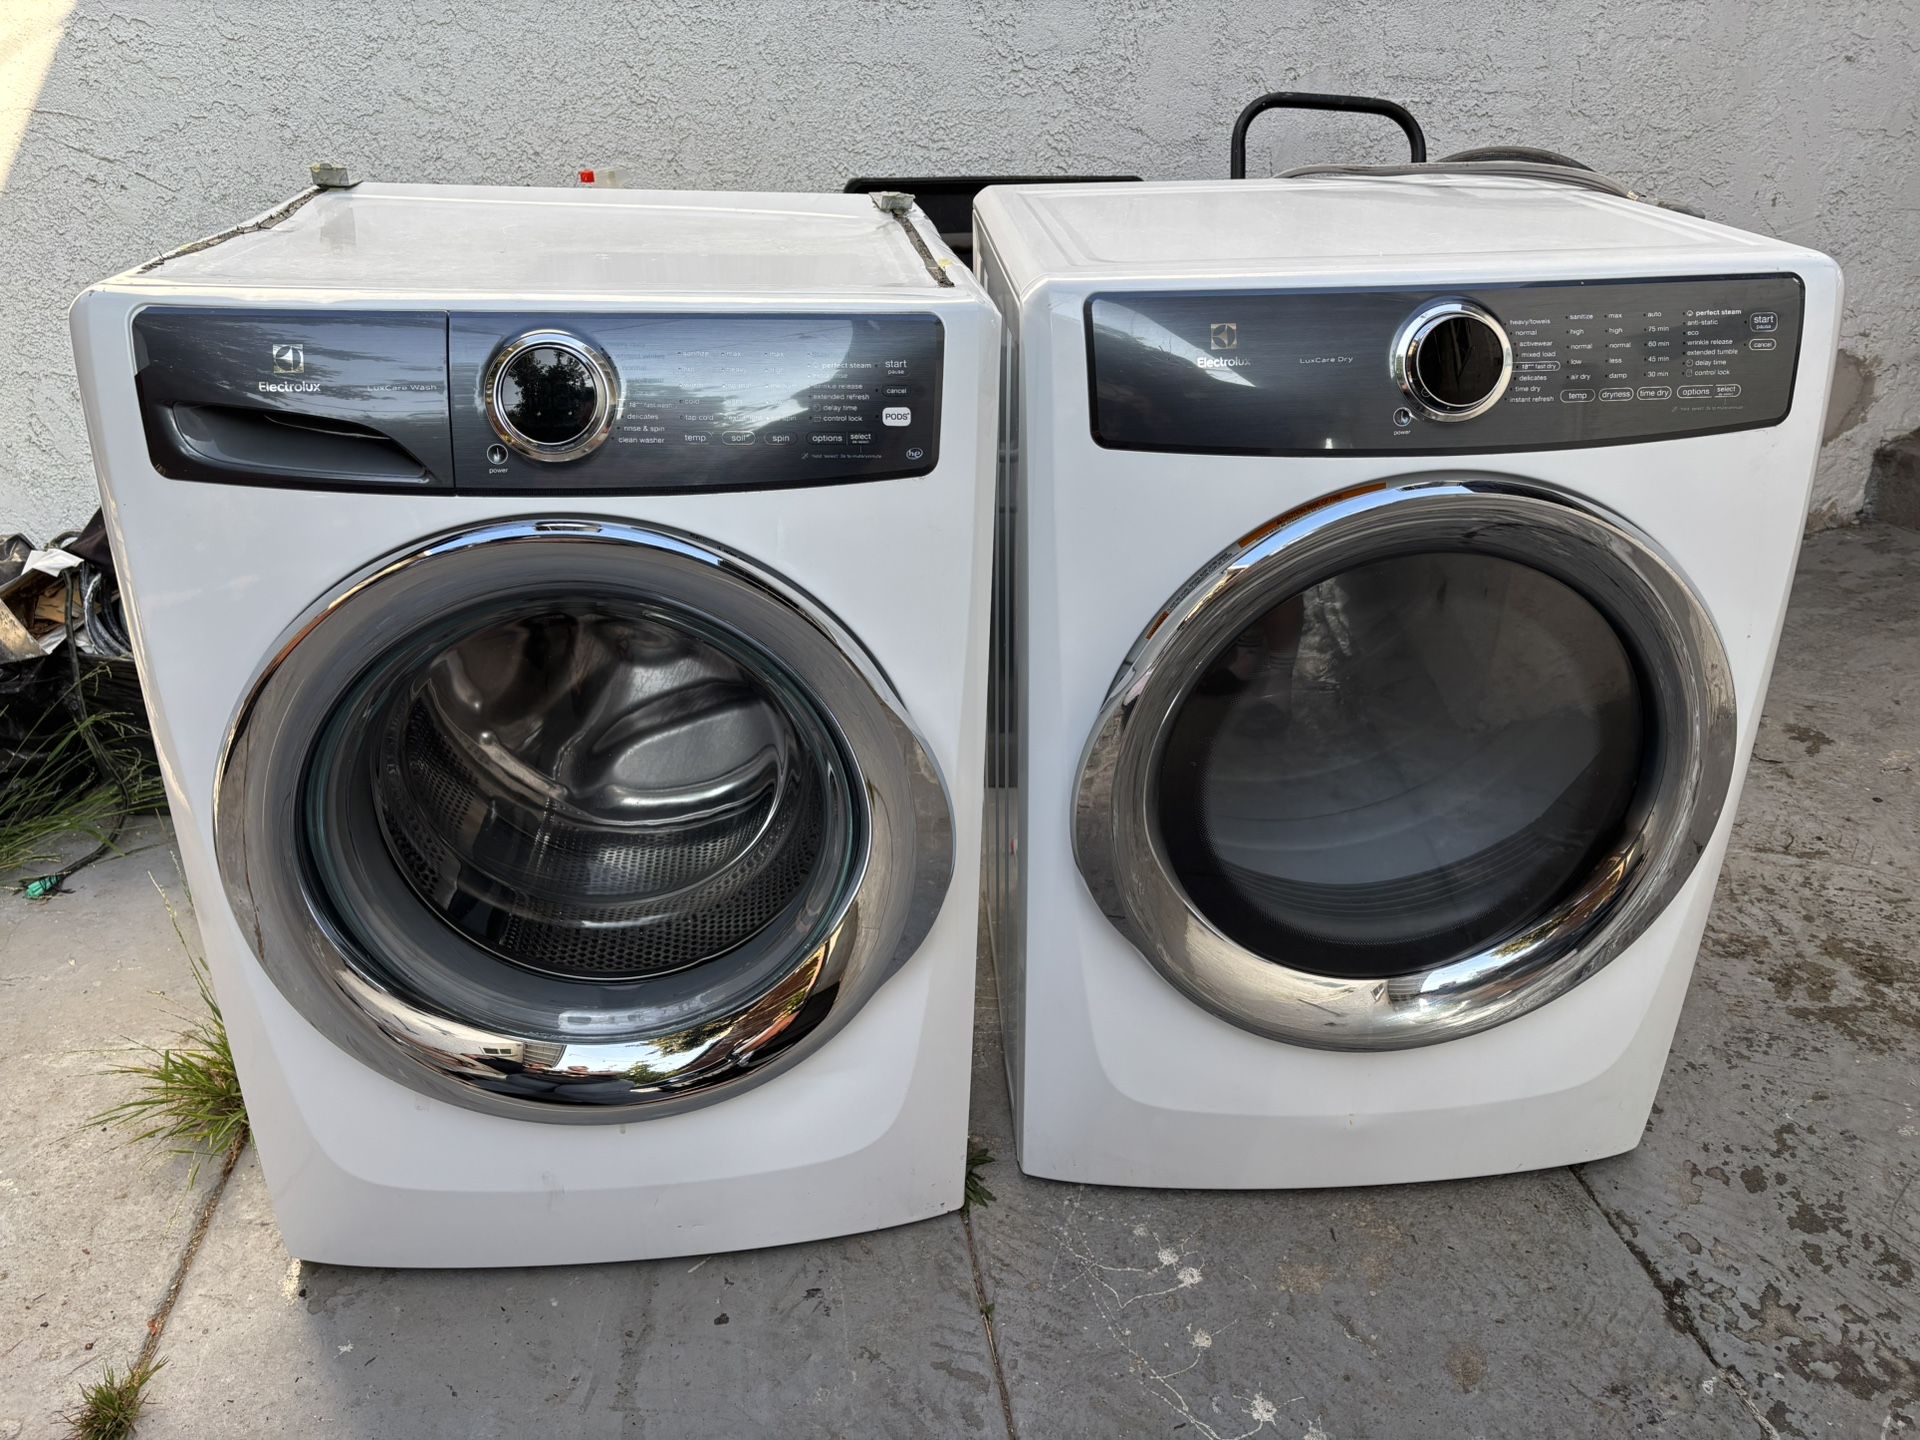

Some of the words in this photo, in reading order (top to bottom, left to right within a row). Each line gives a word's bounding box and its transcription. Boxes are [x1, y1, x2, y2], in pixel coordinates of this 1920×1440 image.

[1695, 309, 1720, 318] perfect
[1753, 314, 1774, 324] start
[885, 359, 907, 368] start
[1197, 356, 1250, 368] Electrolux
[1338, 356, 1353, 364] Dry
[1695, 359, 1712, 367] delay
[1580, 373, 1591, 381] dry
[1609, 372, 1628, 380] damp
[258, 381, 321, 393] Electrolux
[367, 384, 407, 392] LuxCare
[1602, 391, 1631, 399] dryness
[1640, 388, 1656, 397] time
[1657, 388, 1669, 398] dry
[1682, 387, 1710, 396] options
[1568, 392, 1588, 400] temp
[650, 425, 665, 433] spin
[618, 436, 638, 444] clean
[640, 436, 665, 444] washer
[684, 434, 707, 443] temp
[731, 434, 747, 442] soil
[772, 434, 790, 444] spin
[812, 433, 842, 443] options
[488, 467, 508, 475] power
